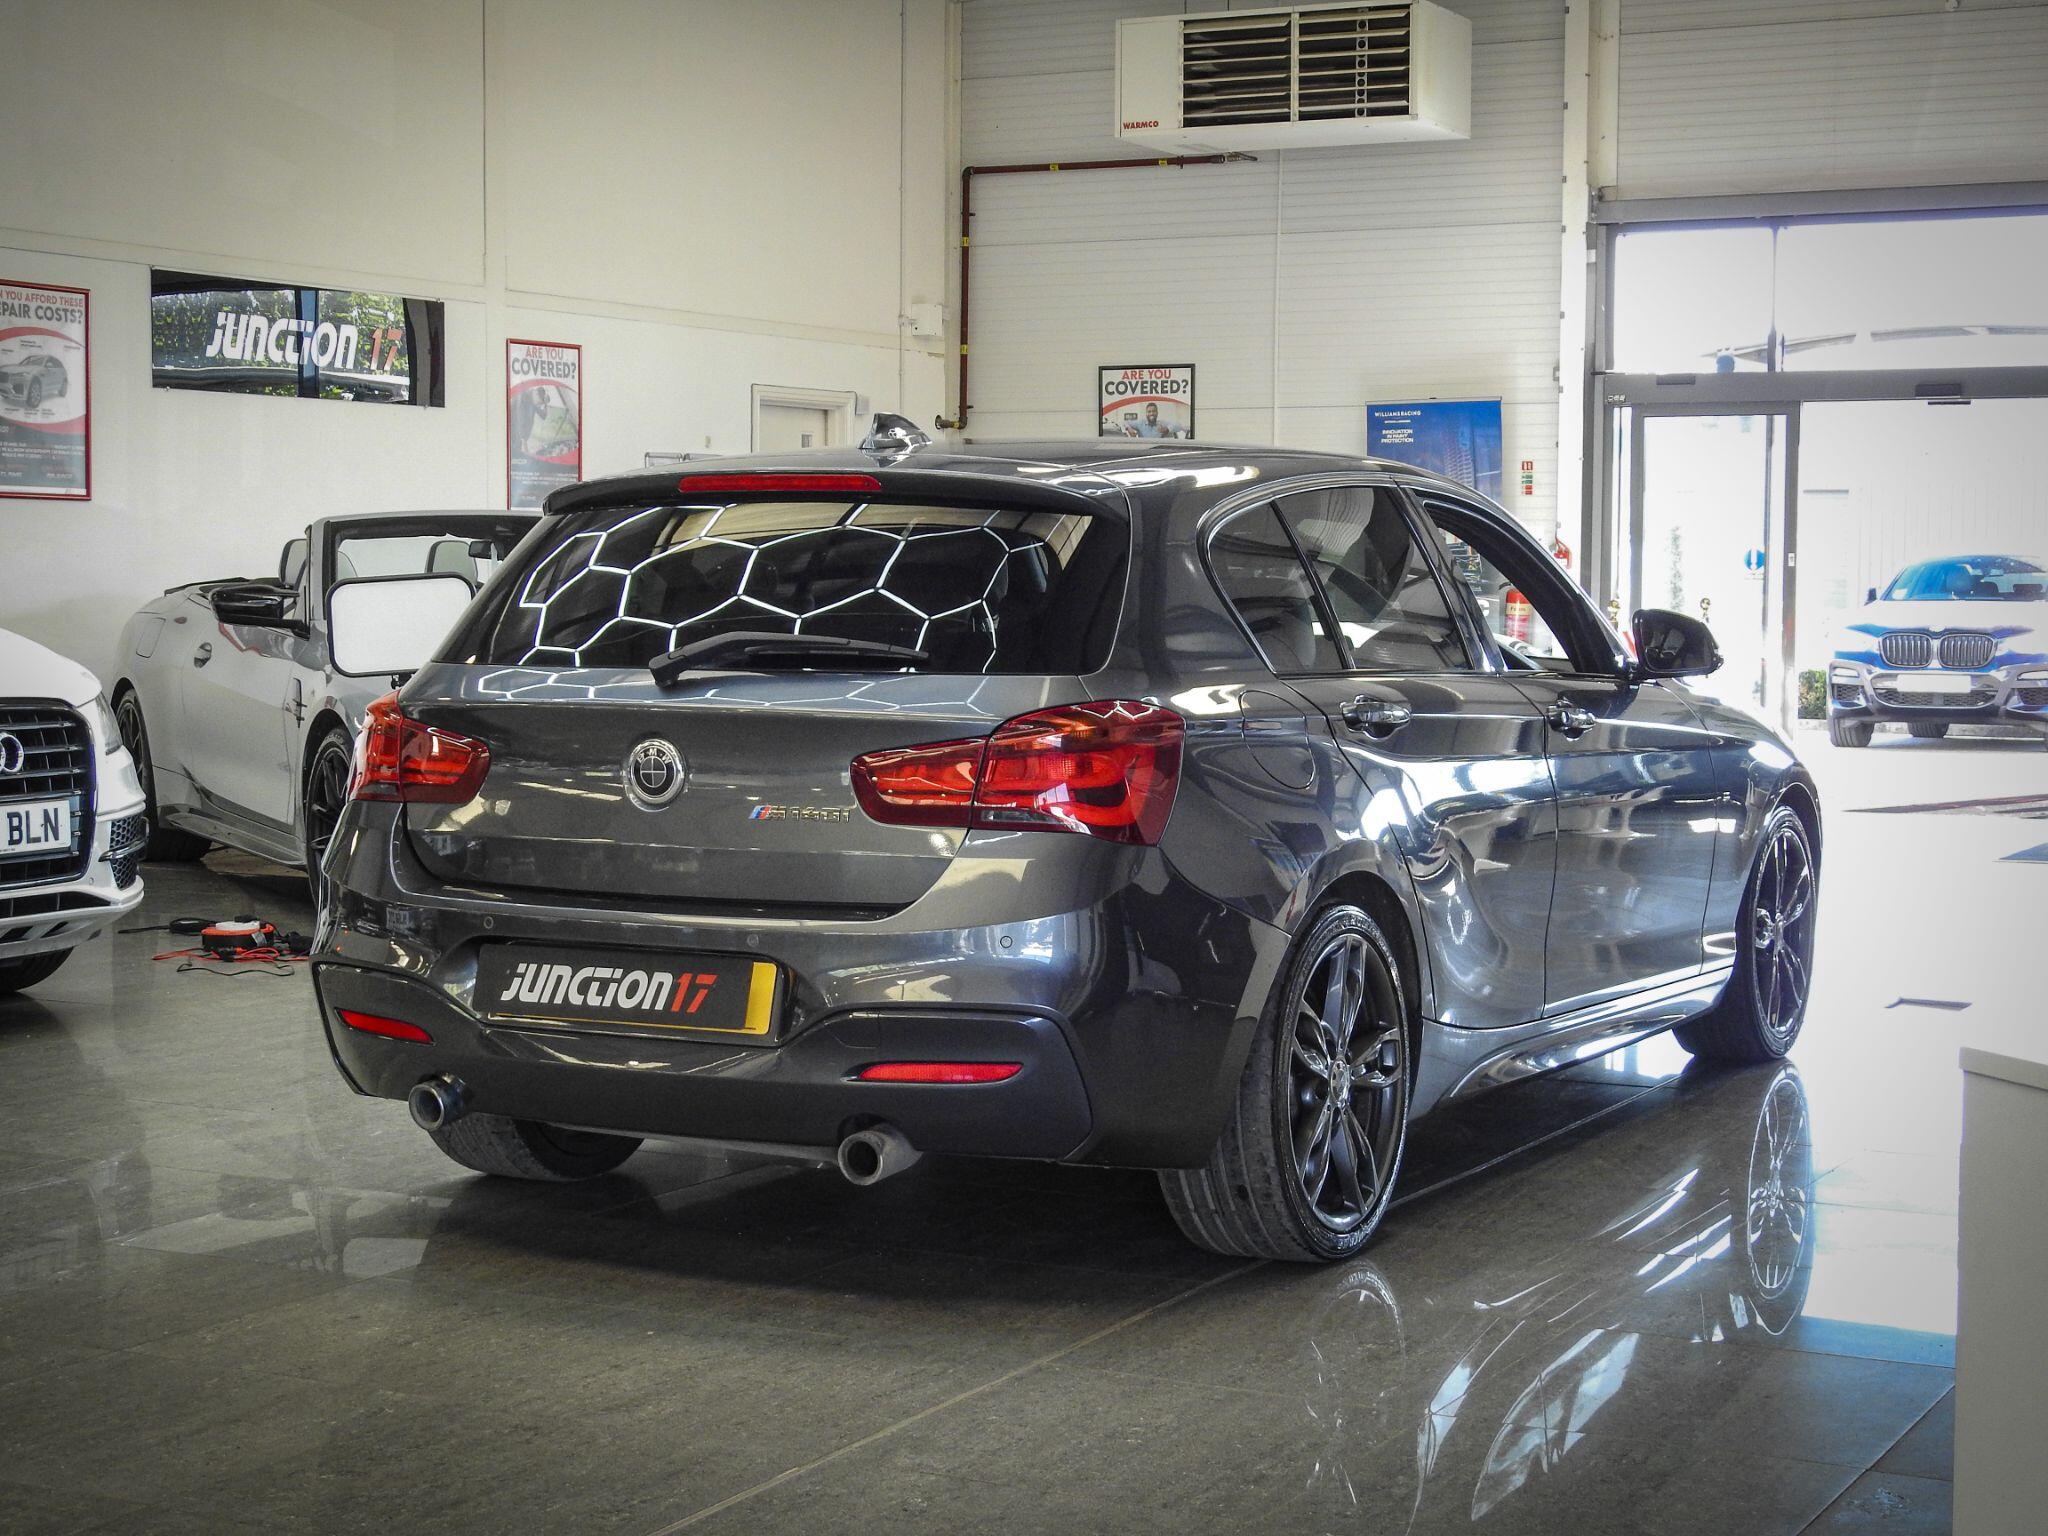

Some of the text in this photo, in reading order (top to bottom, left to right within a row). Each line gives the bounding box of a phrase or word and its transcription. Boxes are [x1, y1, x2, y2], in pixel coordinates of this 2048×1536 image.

[1123, 120, 1159, 129] WARMCO
[6, 290, 22, 301] YOU
[25, 293, 57, 305] AFFORD
[60, 296, 83, 308] THESE
[0, 301, 84, 324] PAIR COSTS?
[206, 311, 405, 371] JUNCTION 17
[525, 345, 564, 360] ARE YOU
[512, 357, 577, 379] COVERED?
[1122, 369, 1172, 380] ARE YOU
[1105, 379, 1189, 395] COVERED?
[7, 808, 60, 846] BLN
[500, 962, 718, 1014] JUNCTION 17
